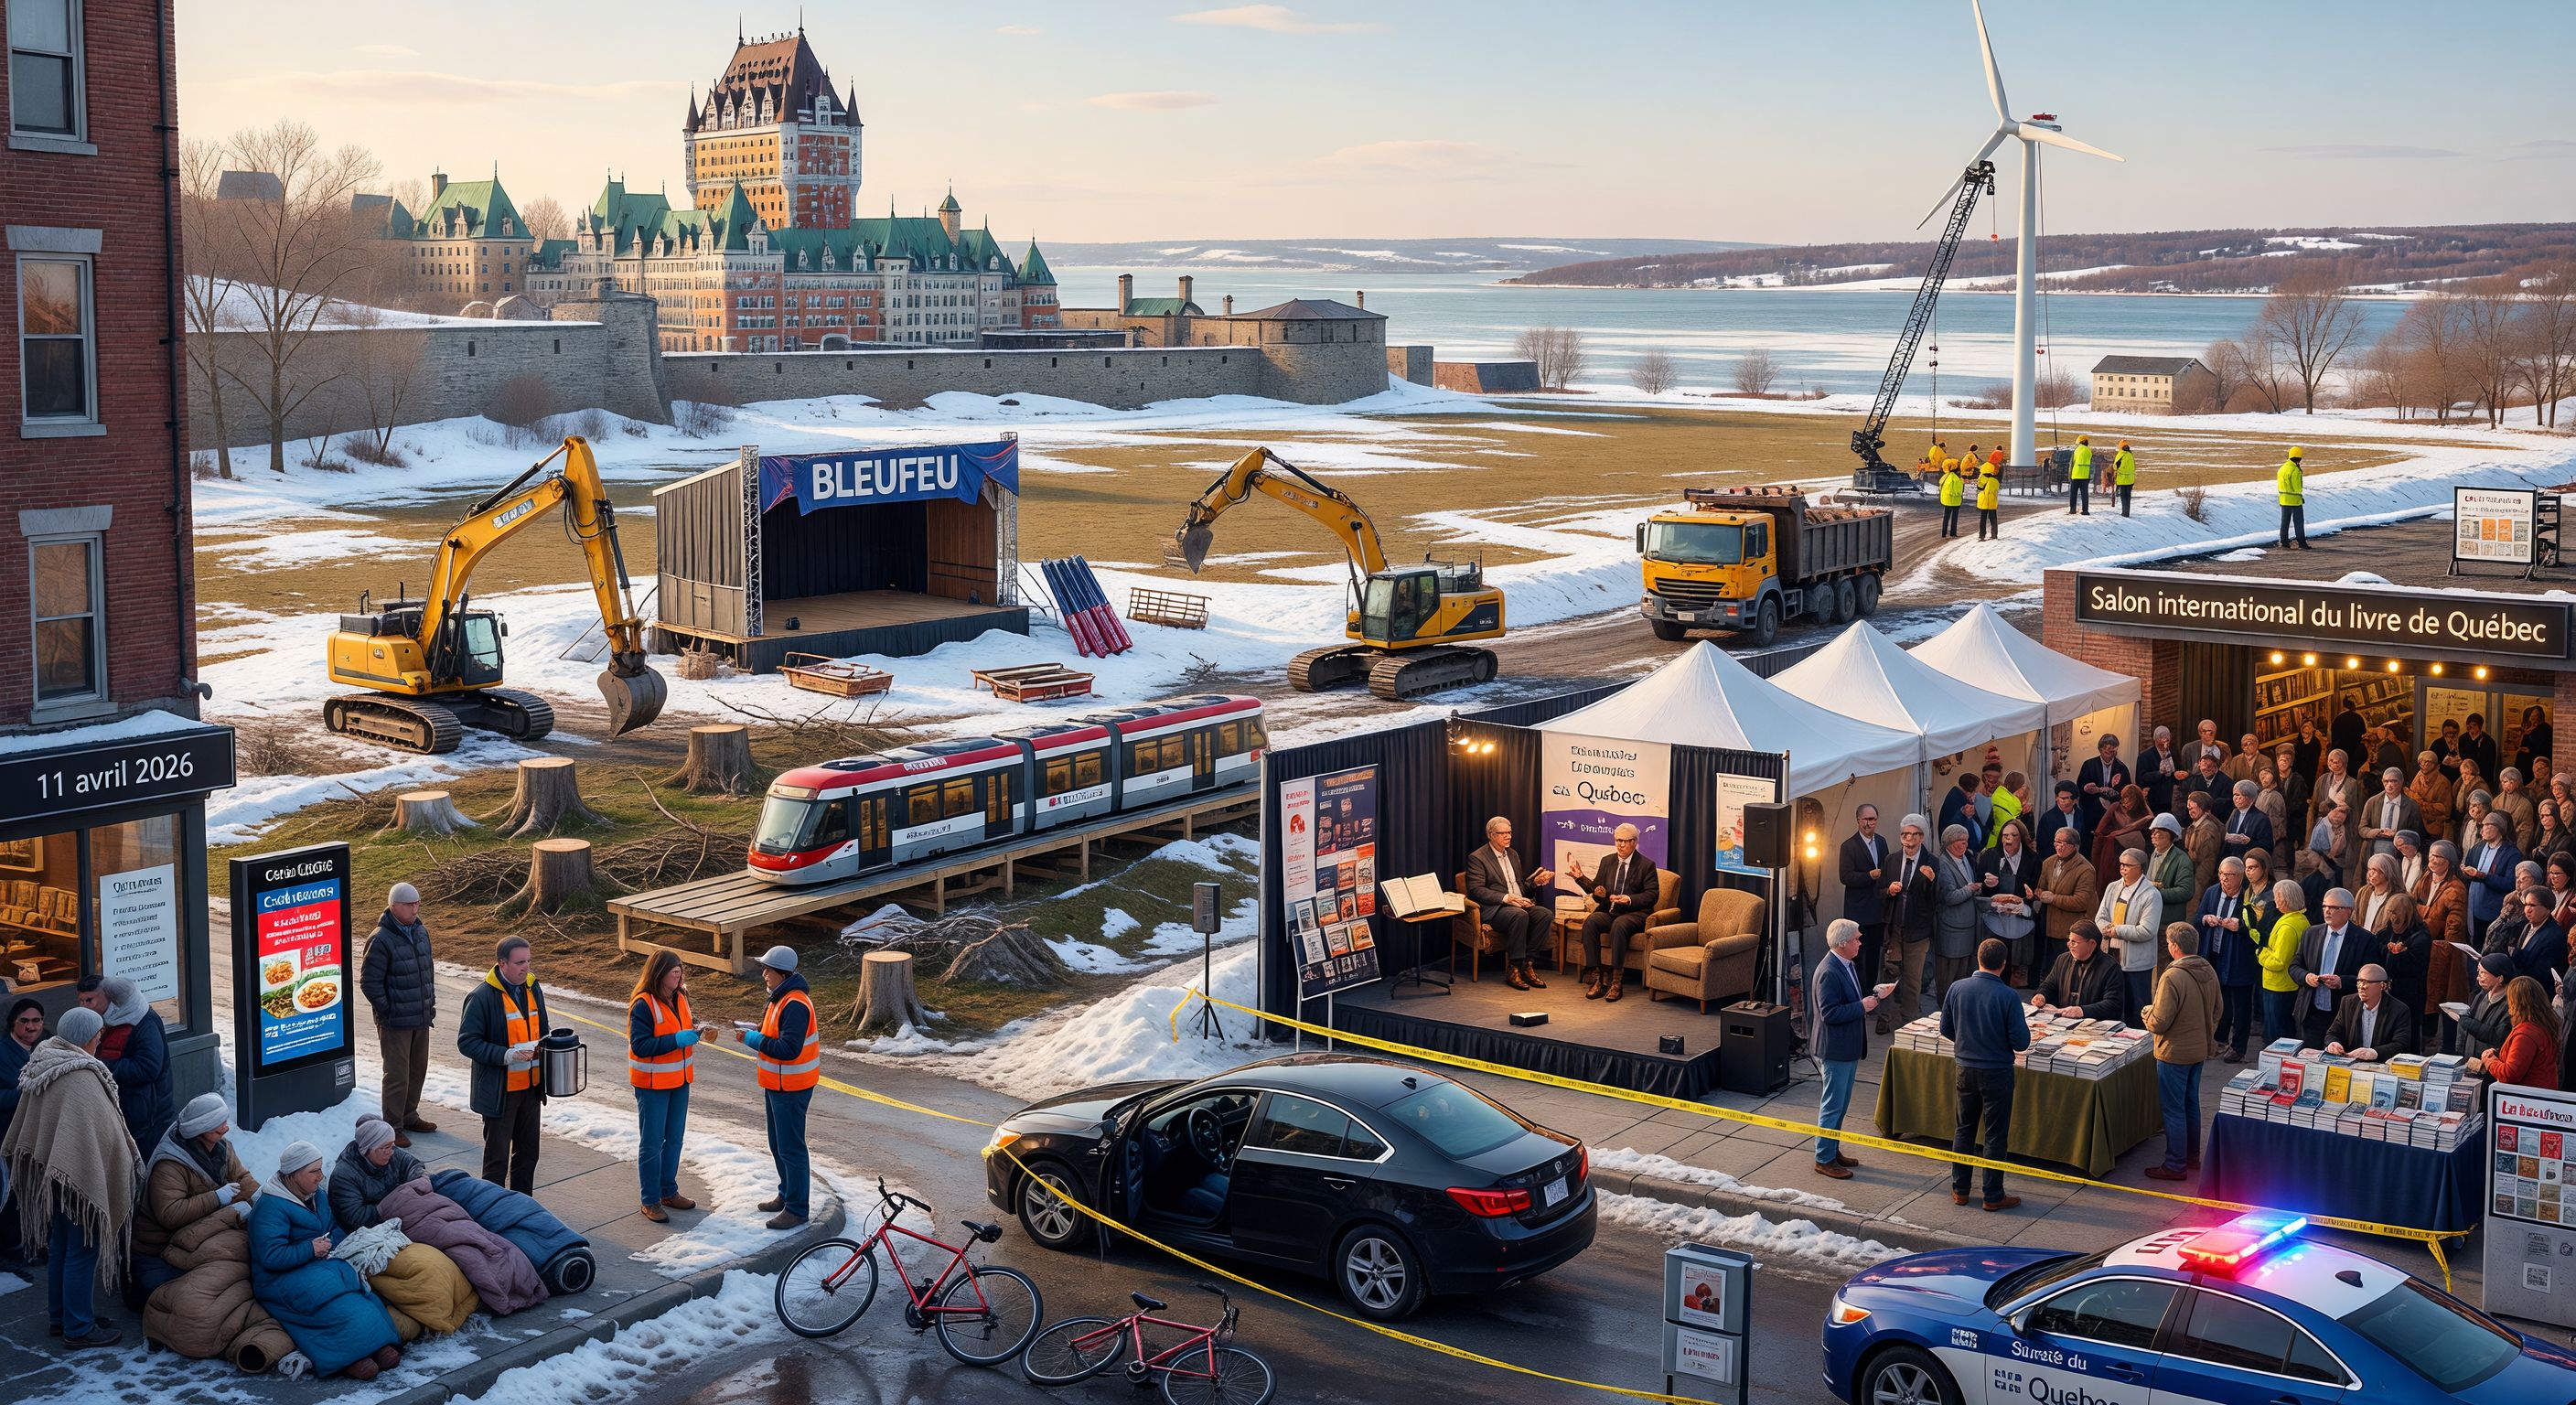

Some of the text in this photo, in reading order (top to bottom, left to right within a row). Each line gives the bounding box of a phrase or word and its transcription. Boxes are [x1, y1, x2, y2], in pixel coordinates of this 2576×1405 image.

[812, 455, 958, 500] BLEUFEU
[2091, 585, 2546, 642] Salon international du livre de Québec
[38, 752, 194, 799] 11 avril 2026
[2068, 1354, 2087, 1369] du
[2029, 1377, 2121, 1405] Queb
